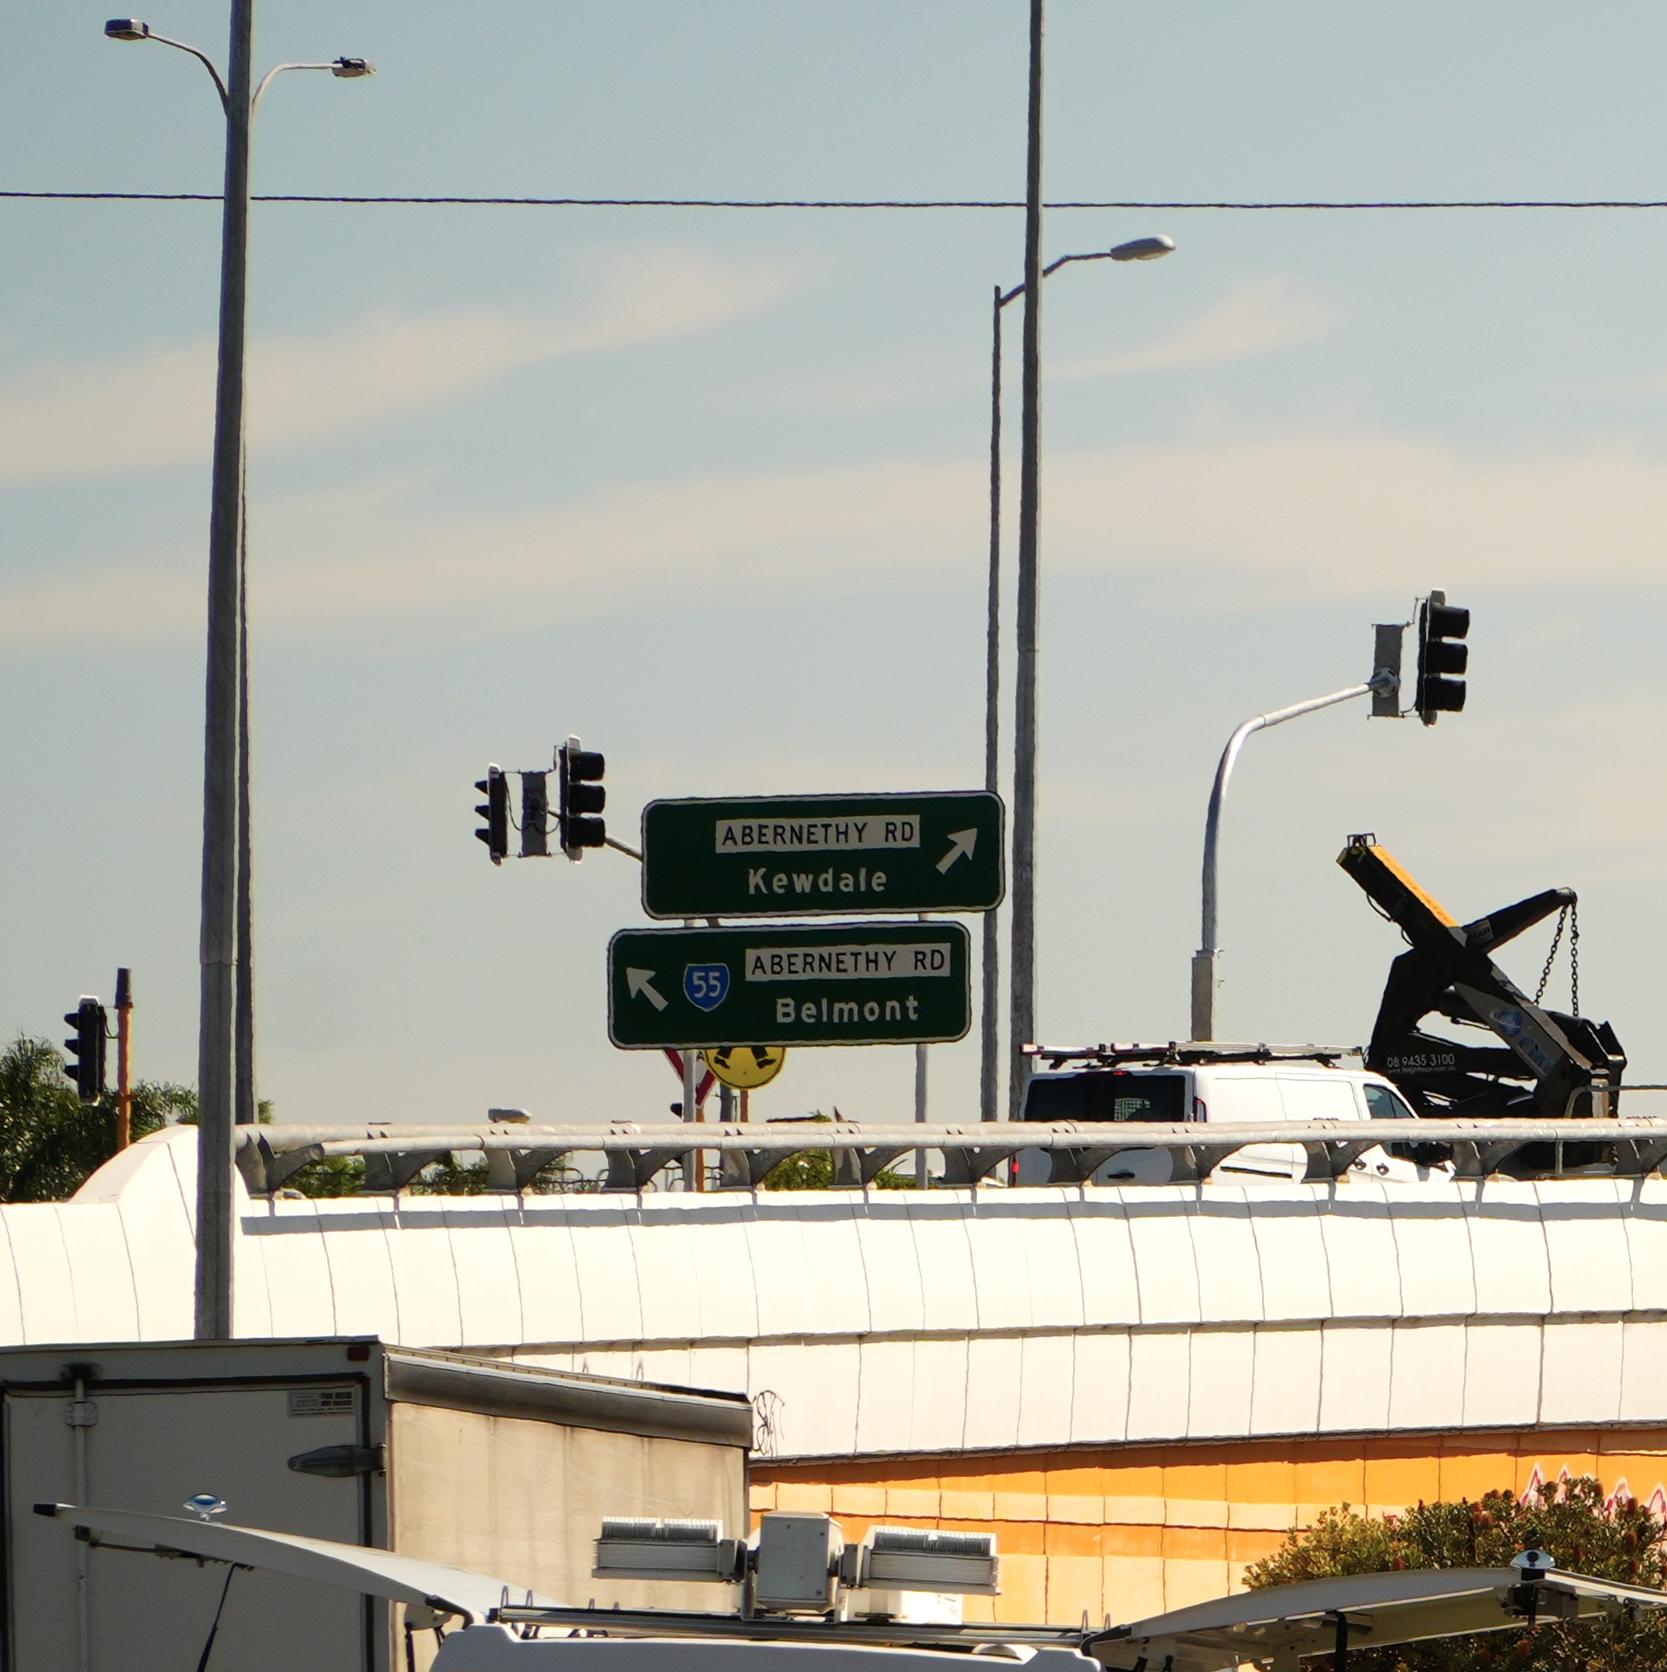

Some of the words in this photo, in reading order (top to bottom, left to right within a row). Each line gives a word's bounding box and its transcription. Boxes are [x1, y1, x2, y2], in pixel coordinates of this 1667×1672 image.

[722, 822, 868, 847] ABERNETHY
[884, 821, 914, 843] RD
[748, 867, 887, 894] Kewdale
[751, 950, 896, 976] ABERNETHY
[914, 949, 945, 972] RD
[692, 972, 721, 998] 55
[776, 995, 919, 1024] Belmont
[1386, 1056, 1400, 1068] 08
[1402, 1054, 1427, 1067] 9435
[1429, 1053, 1455, 1066] 3100
